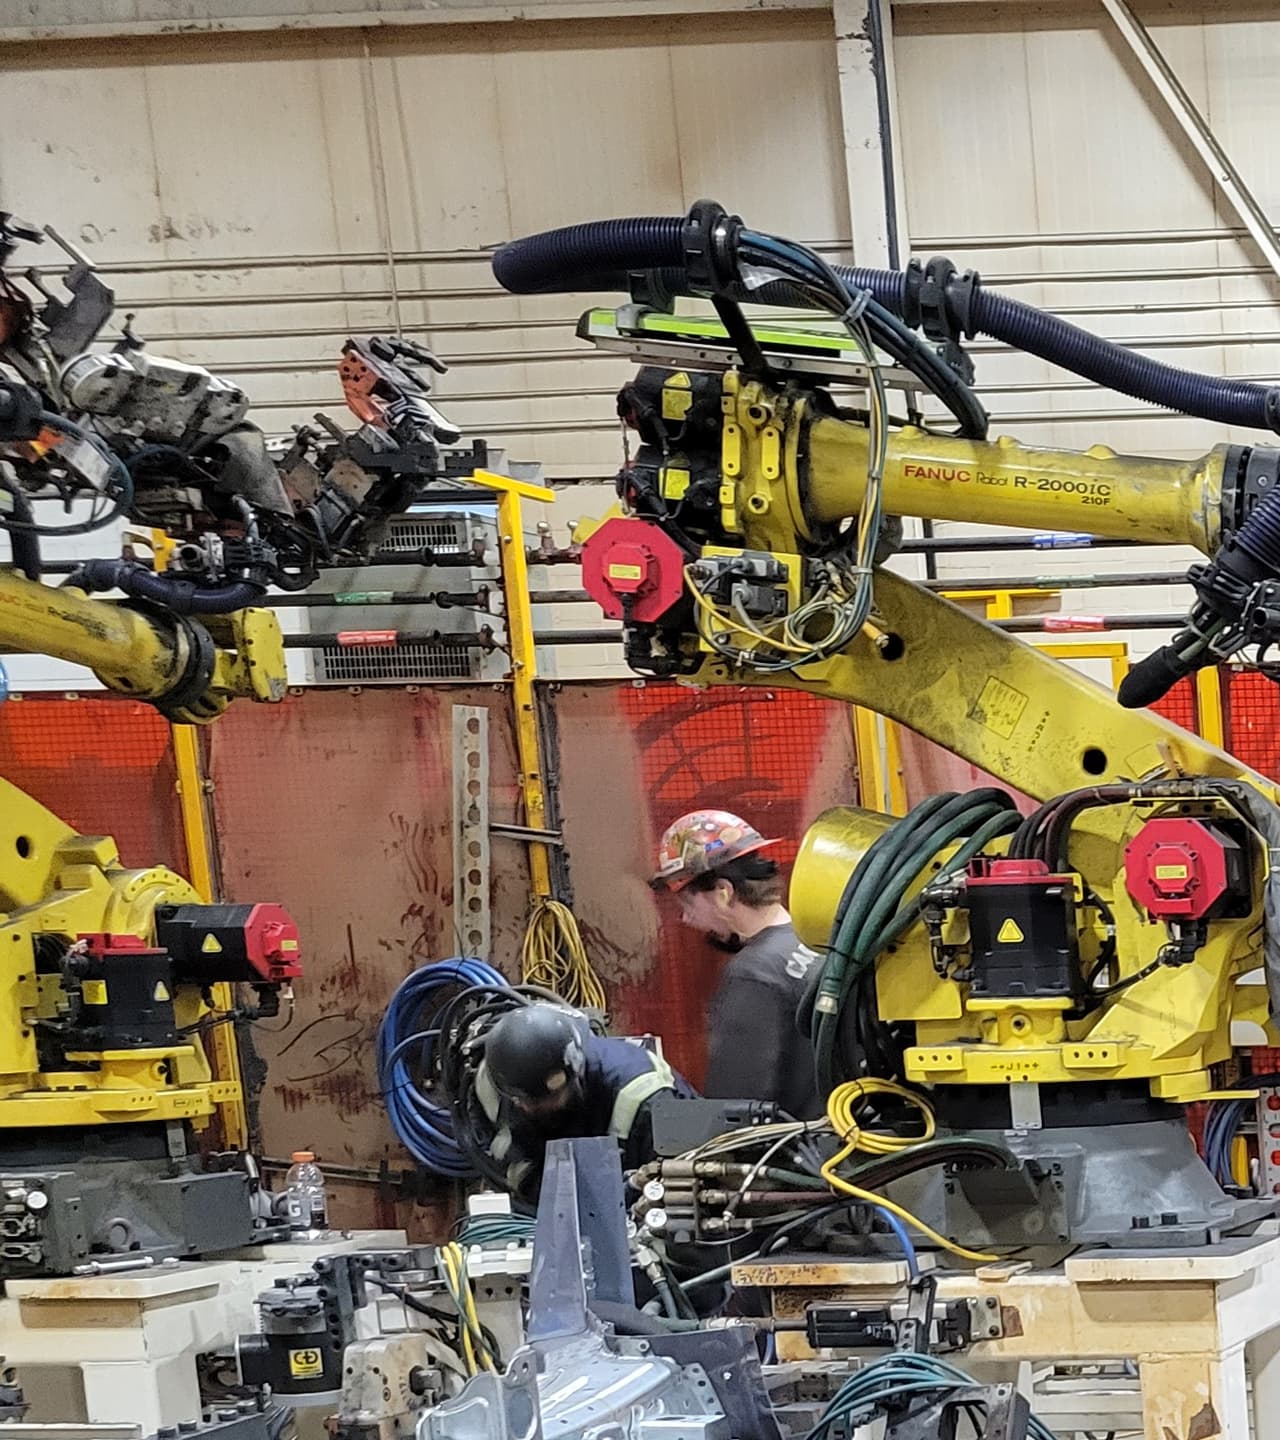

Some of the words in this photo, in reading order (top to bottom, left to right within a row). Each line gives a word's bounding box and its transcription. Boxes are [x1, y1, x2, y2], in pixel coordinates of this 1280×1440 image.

[904, 465, 971, 483] FANUC
[976, 471, 1008, 487] Robot
[1014, 476, 1111, 497] R-2000iC
[1081, 496, 1111, 506] 210F
